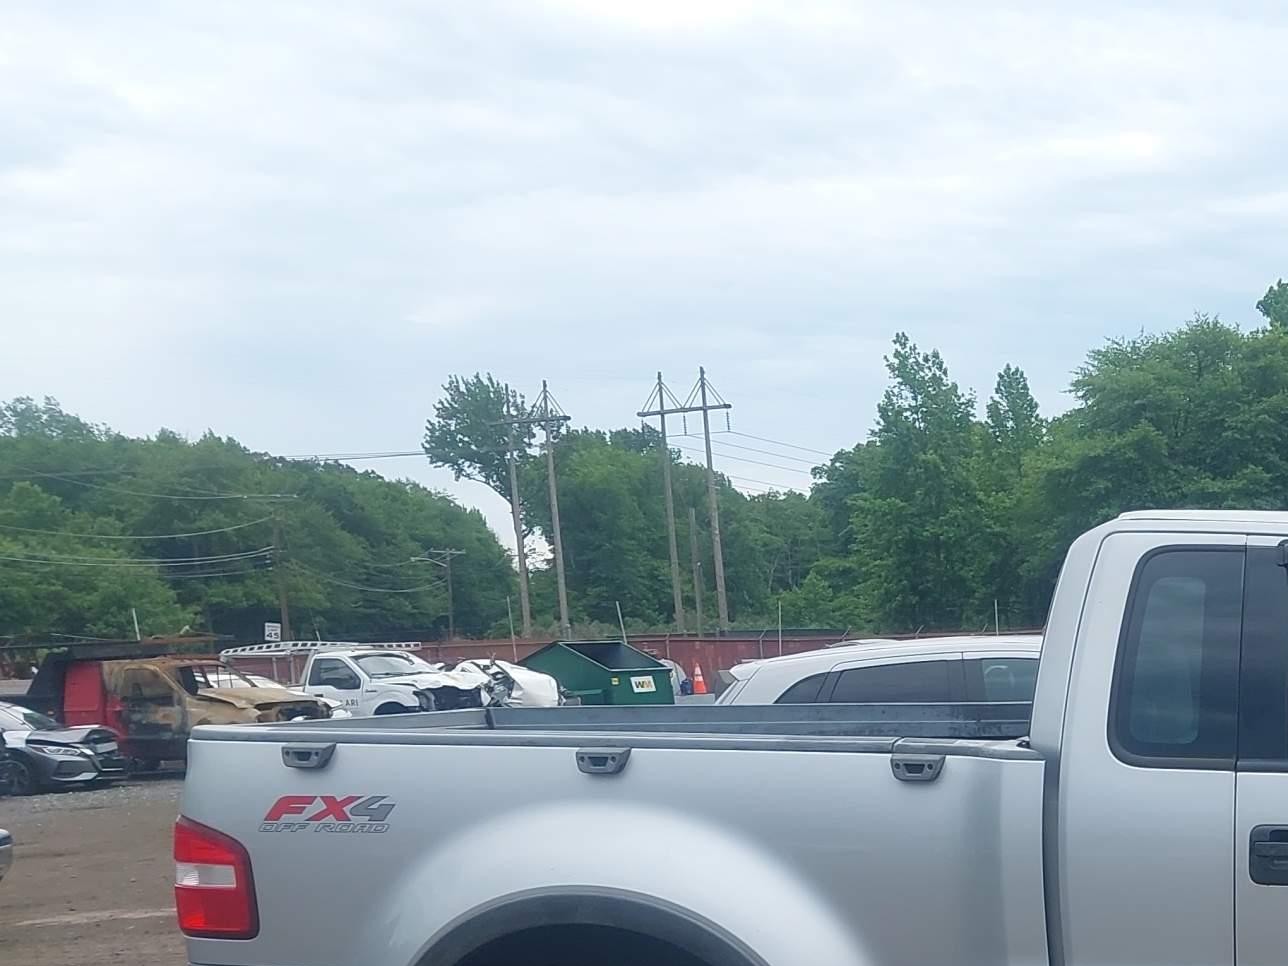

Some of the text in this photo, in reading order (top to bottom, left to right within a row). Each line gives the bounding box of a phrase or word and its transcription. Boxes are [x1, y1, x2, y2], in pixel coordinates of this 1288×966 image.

[266, 632, 280, 640] 45
[634, 680, 653, 688] WM
[263, 795, 396, 821] FX4
[259, 822, 390, 833] OFF ROAD
